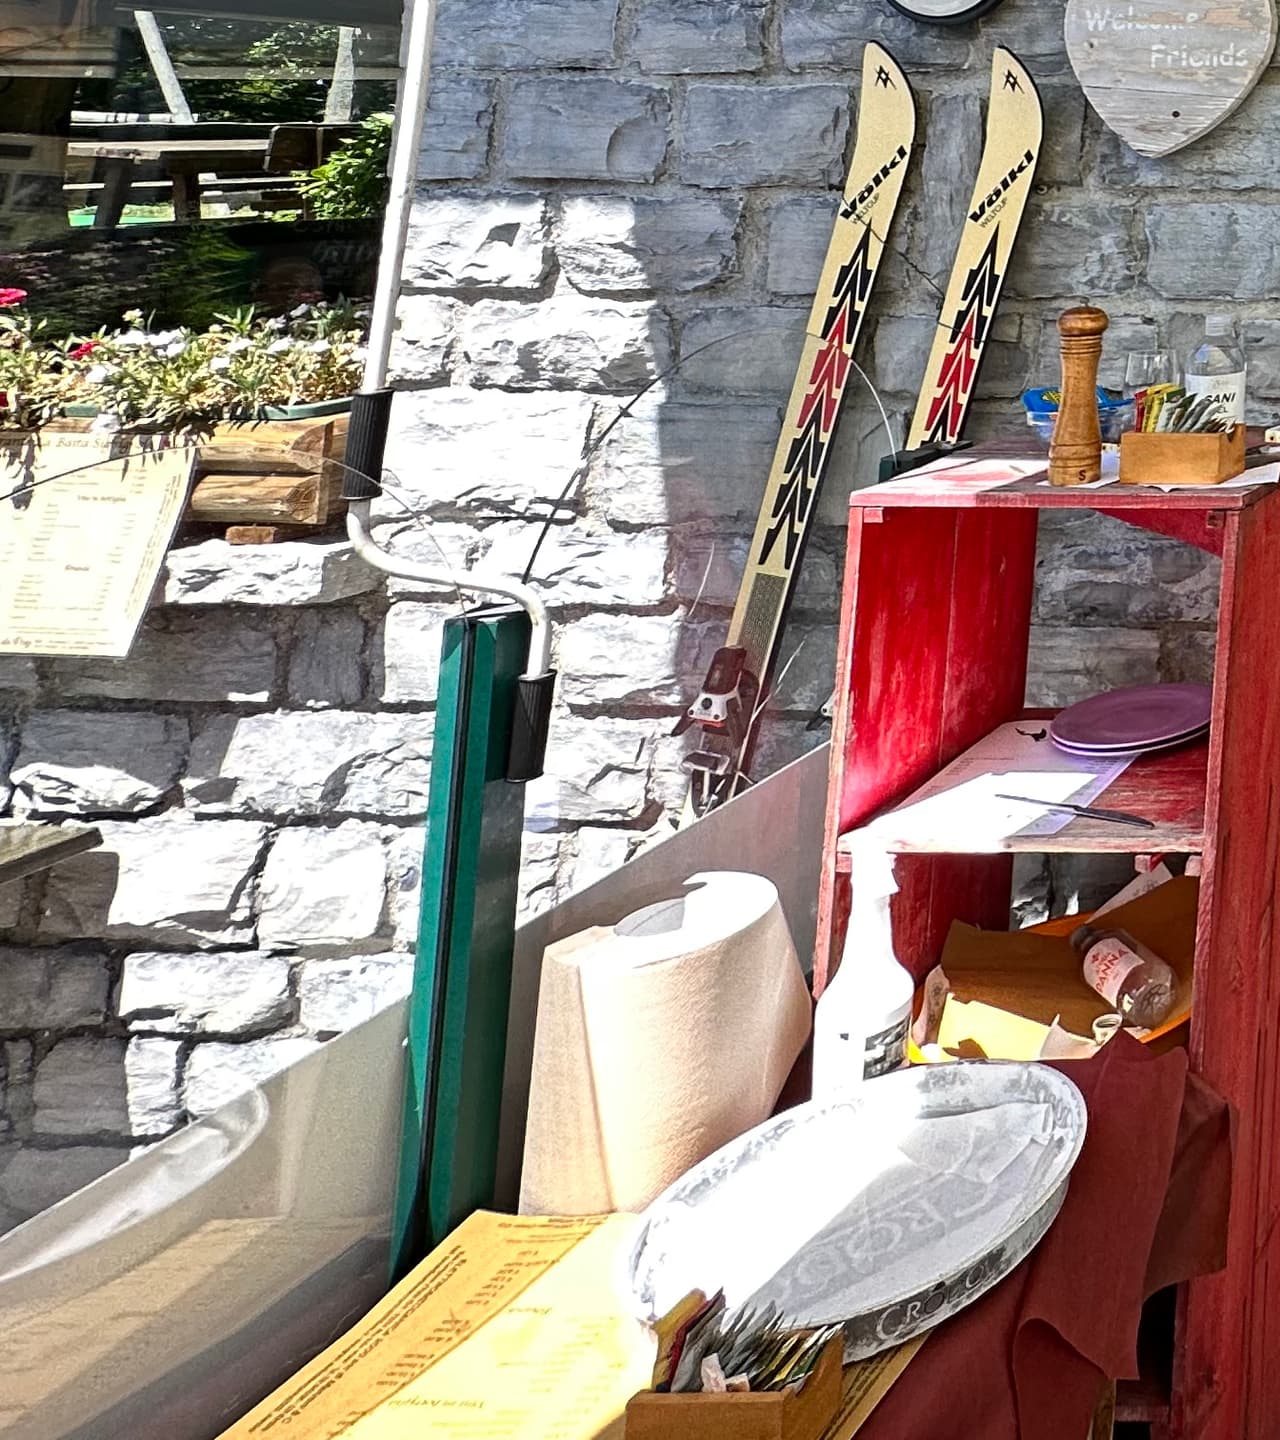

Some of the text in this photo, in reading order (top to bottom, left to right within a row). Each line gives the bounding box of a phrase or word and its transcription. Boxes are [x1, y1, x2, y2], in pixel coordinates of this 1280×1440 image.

[1150, 42, 1249, 68] Friends
[1078, 469, 1086, 480] S
[1096, 949, 1128, 993] PANNA
